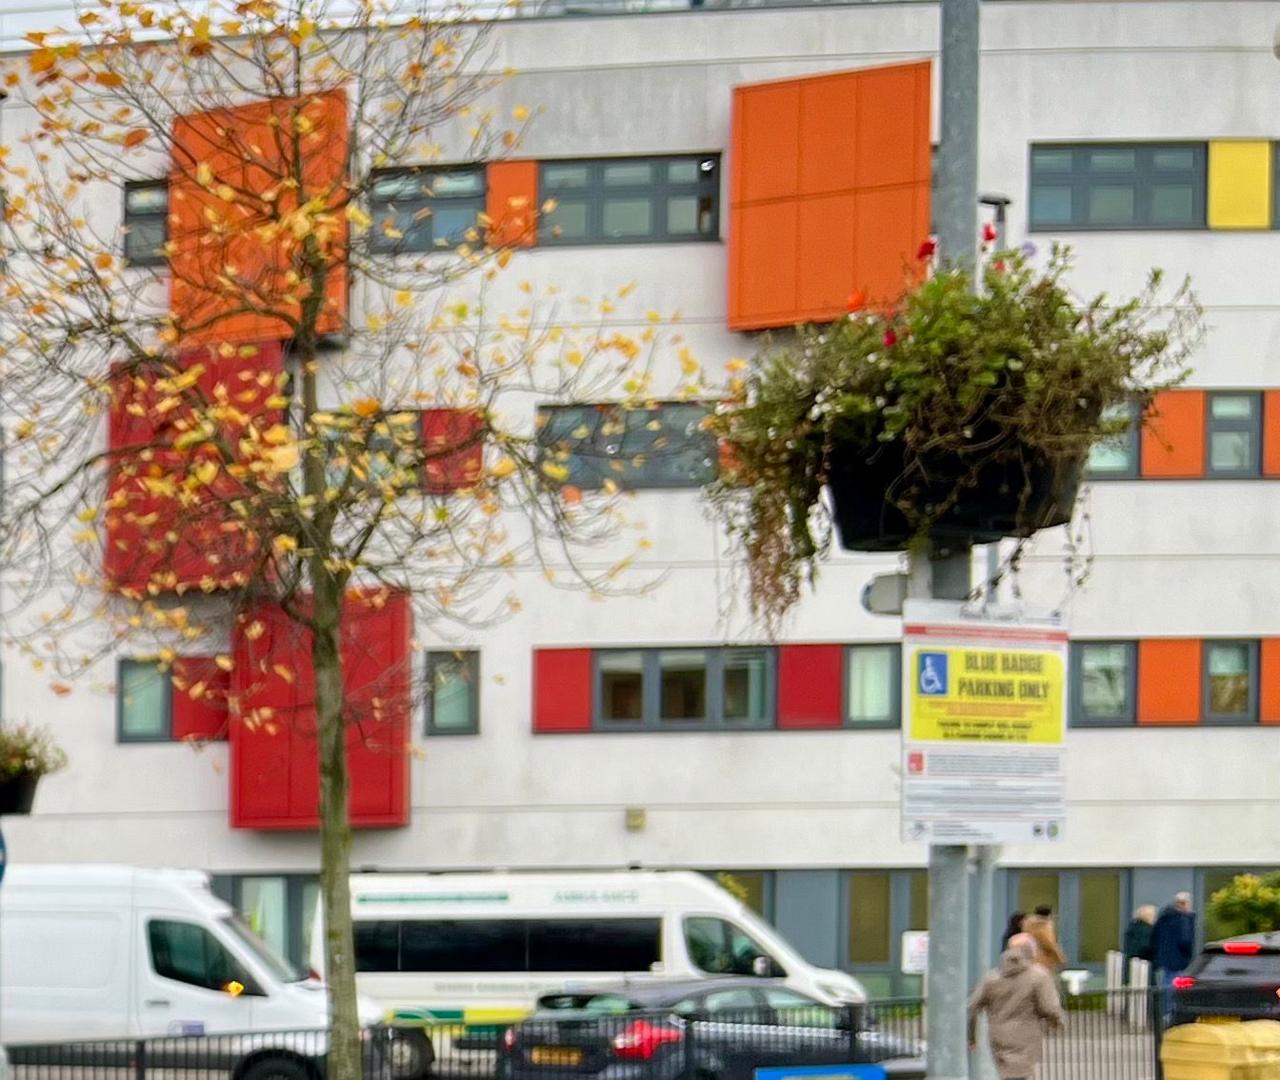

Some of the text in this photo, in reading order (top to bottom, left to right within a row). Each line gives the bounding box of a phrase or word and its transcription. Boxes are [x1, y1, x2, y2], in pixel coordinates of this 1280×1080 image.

[965, 652, 1044, 674] BLUE BADGE
[958, 679, 1049, 699] PARKING ONLY
